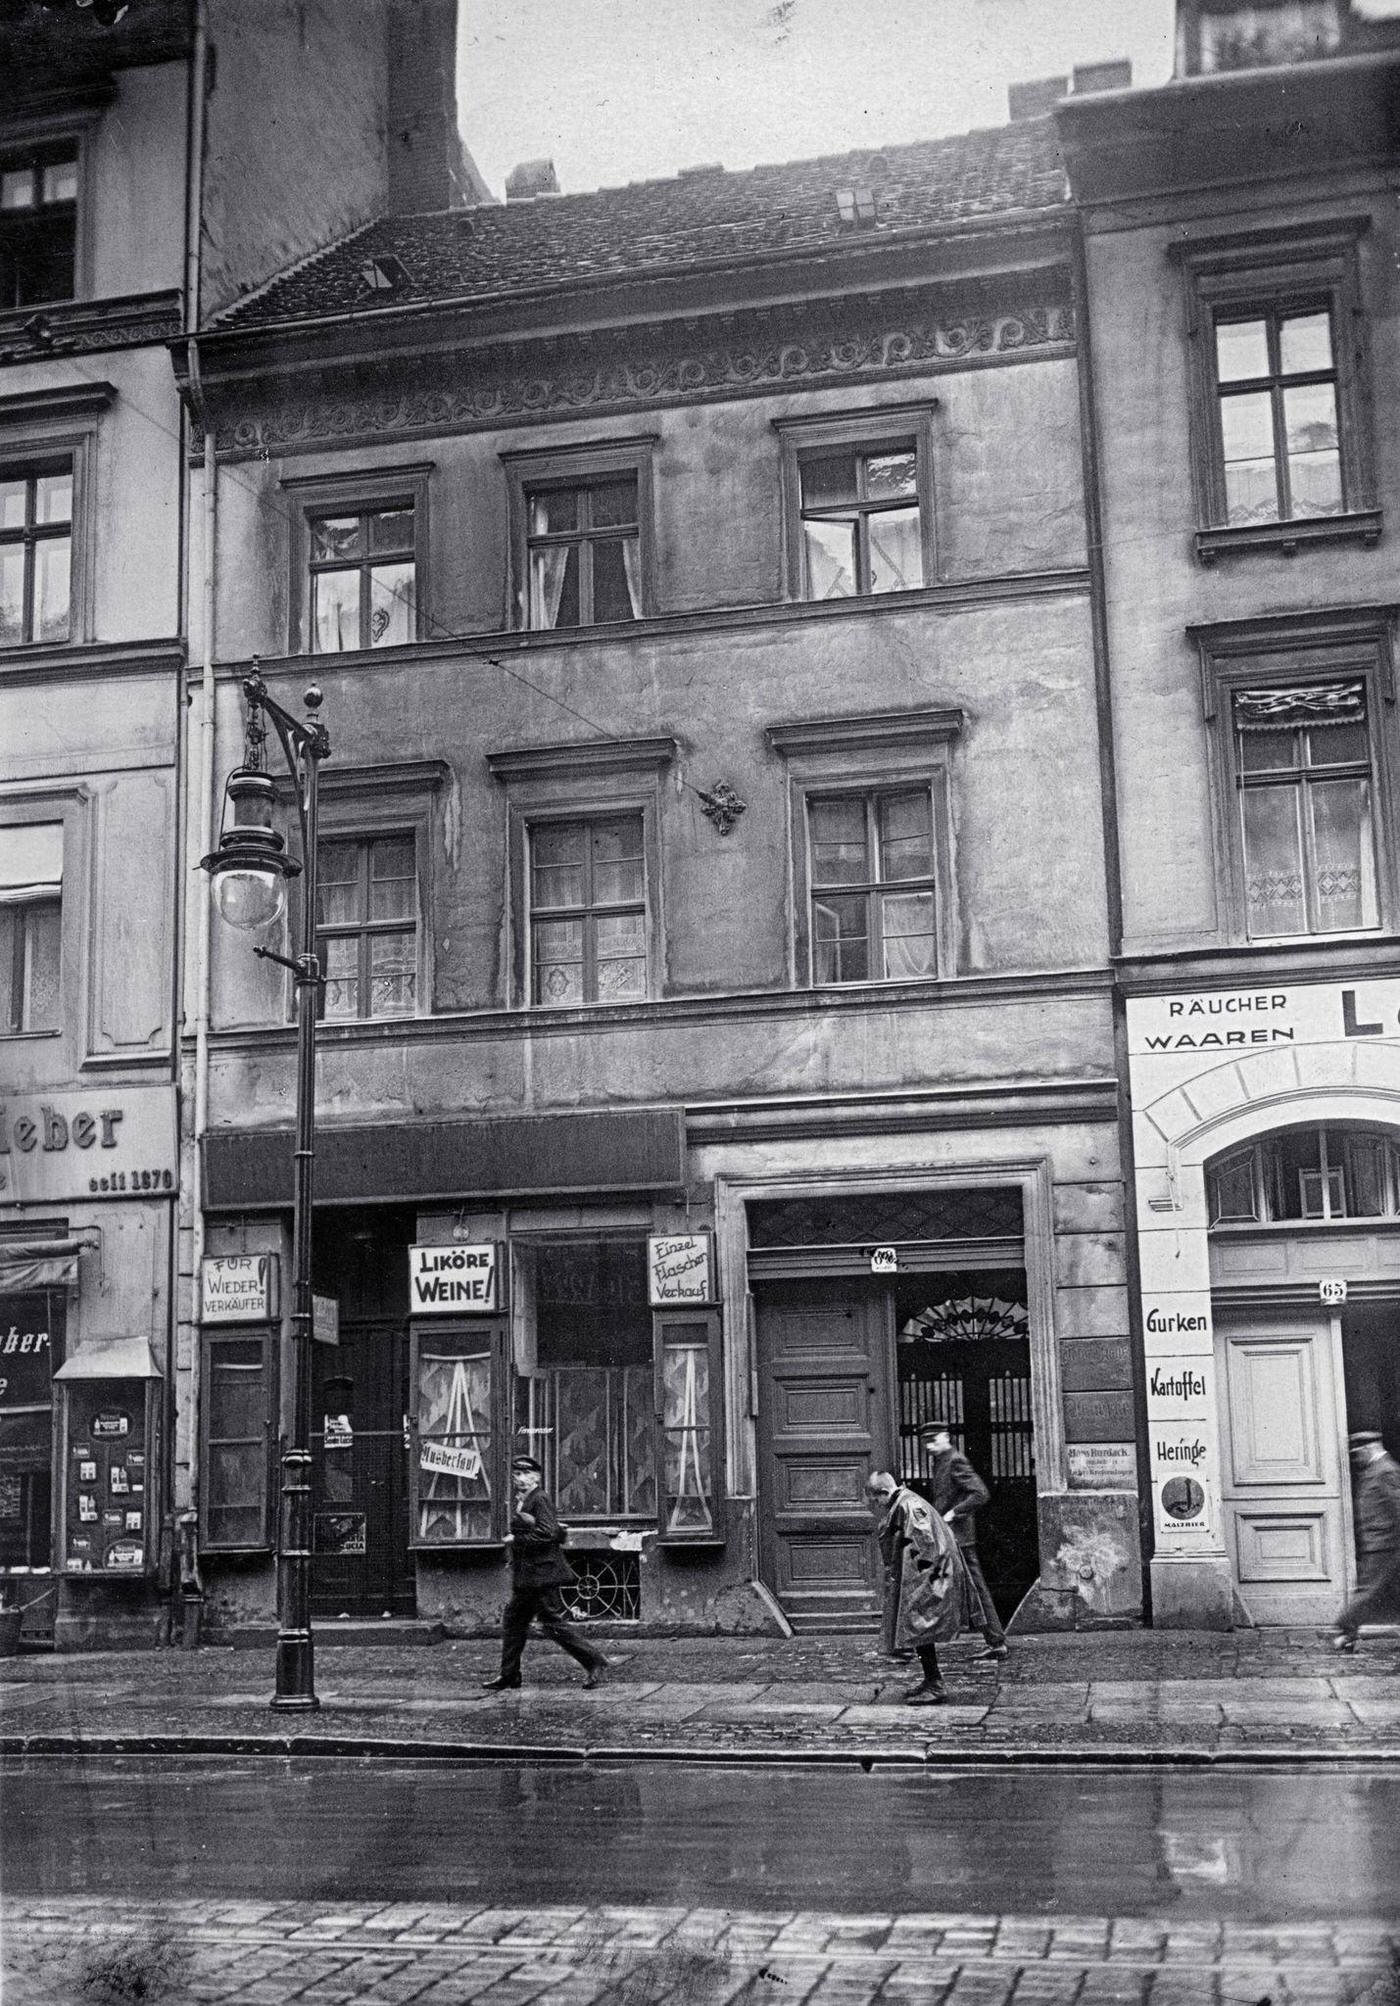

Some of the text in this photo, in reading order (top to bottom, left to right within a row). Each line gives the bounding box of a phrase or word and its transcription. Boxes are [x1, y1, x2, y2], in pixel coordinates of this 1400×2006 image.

[1169, 994, 1288, 1017] RÄUCHER
[1144, 1027, 1295, 1050] WAAREN
[89, 1173, 126, 1192] seit
[654, 1236, 698, 1260] Einzel
[213, 1257, 252, 1272] FÜR
[420, 1250, 490, 1273] LIKÖRE
[652, 1252, 707, 1284] Flaschen
[415, 1266, 495, 1304] WEINE!
[656, 1280, 707, 1301] Verkauf
[1323, 1283, 1343, 1297] 65
[204, 1297, 265, 1313] VERKÄUFER
[1146, 1308, 1207, 1333] Gurken
[1150, 1367, 1207, 1401] Kartoffel
[1157, 1438, 1207, 1467] Heringe
